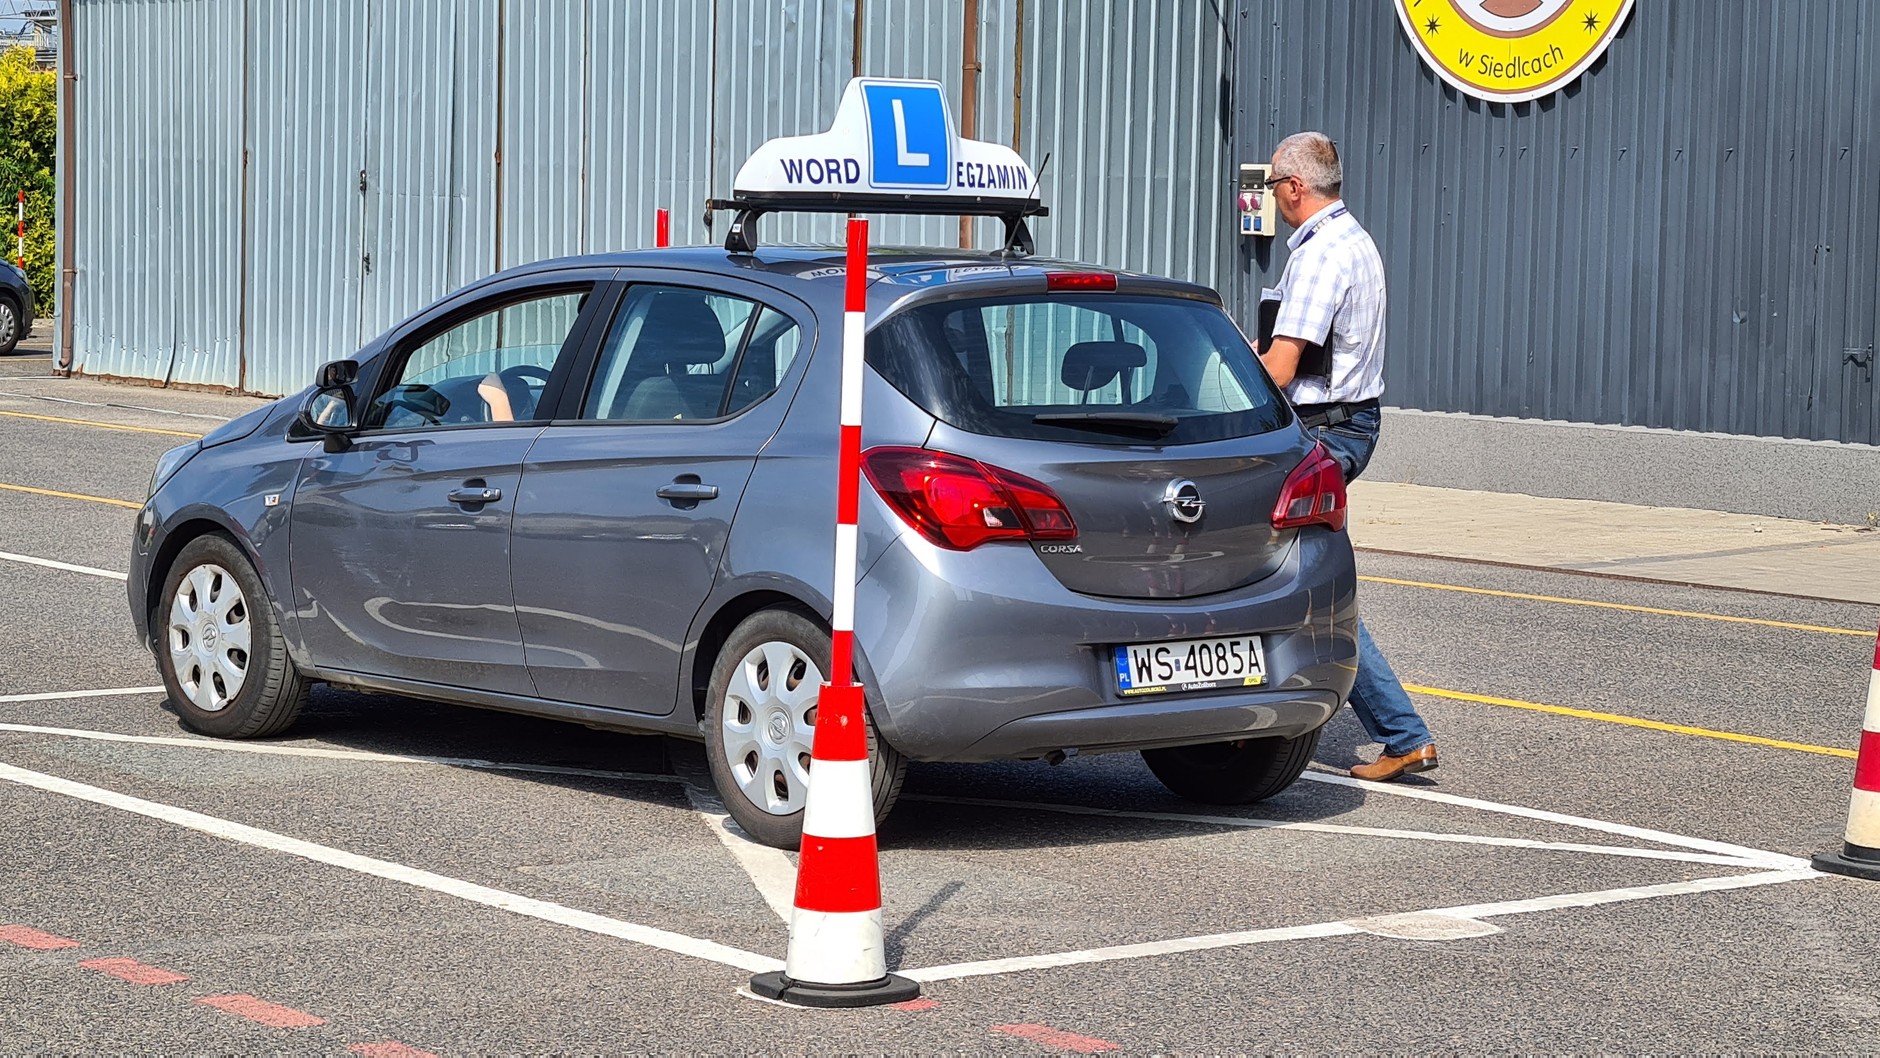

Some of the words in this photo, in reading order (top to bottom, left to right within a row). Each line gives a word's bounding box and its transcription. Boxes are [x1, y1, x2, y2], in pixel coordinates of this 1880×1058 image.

[1458, 48, 1474, 68] w
[1478, 44, 1564, 79] Siedlcach
[891, 98, 930, 167] L
[780, 158, 861, 185] WORD
[956, 161, 1028, 191] EGZAMIN
[1040, 544, 1083, 554] CORSA
[1120, 672, 1130, 682] PL
[1133, 647, 1174, 683] WS
[1184, 639, 1262, 678] 4085A
